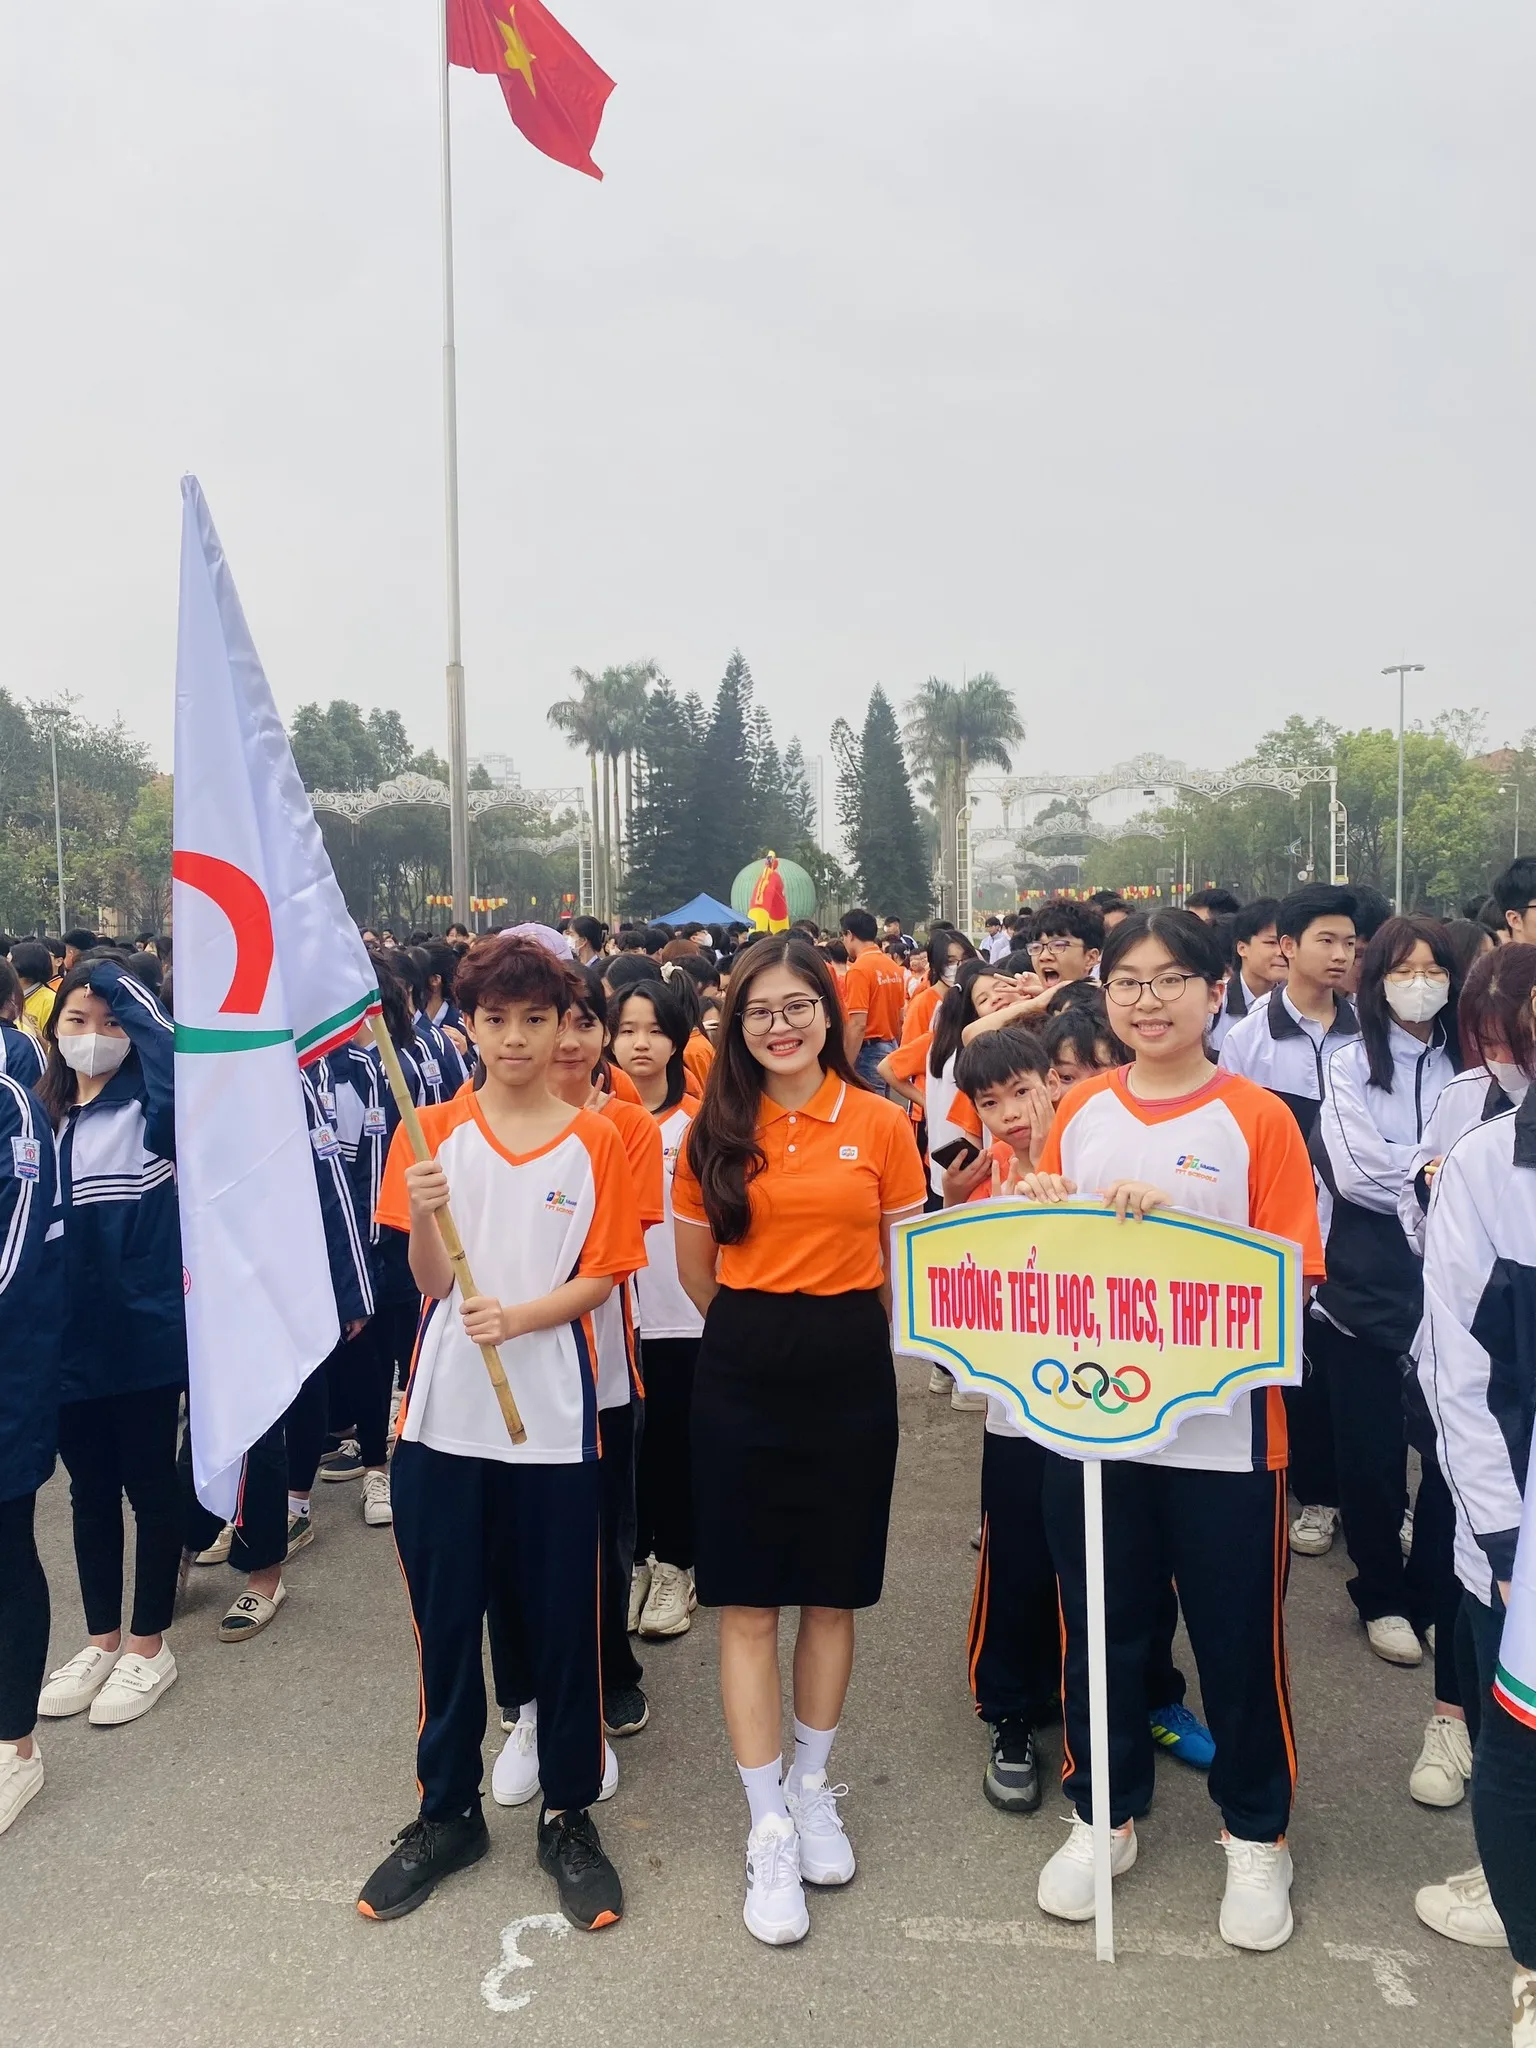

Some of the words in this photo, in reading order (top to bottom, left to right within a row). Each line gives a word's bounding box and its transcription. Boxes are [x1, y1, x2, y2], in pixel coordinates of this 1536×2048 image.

[928, 1253, 1003, 1332] TRƯỜNG
[1008, 1246, 1050, 1336] TIỂU
[1055, 1274, 1101, 1352] HỌC,
[1107, 1278, 1164, 1352] THCS,
[1170, 1281, 1220, 1348] THPT
[1226, 1285, 1263, 1351] FPT
